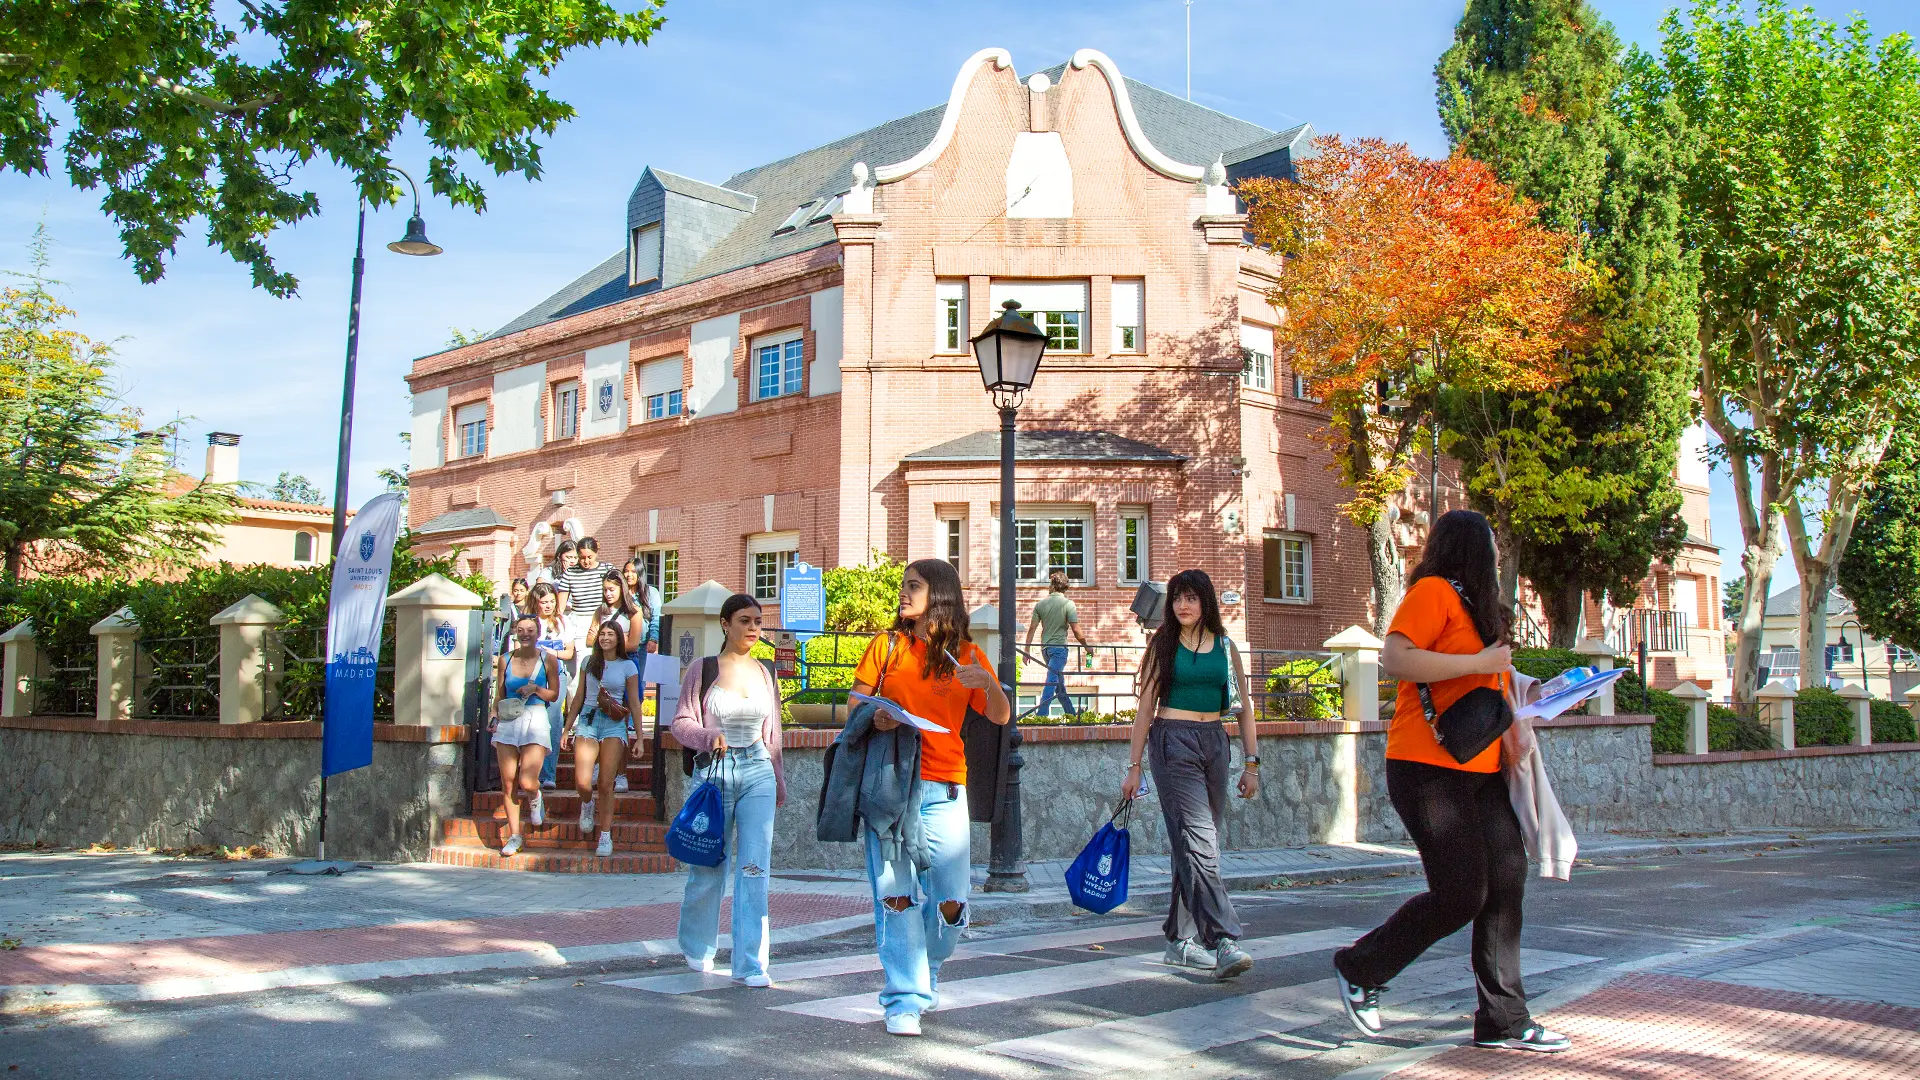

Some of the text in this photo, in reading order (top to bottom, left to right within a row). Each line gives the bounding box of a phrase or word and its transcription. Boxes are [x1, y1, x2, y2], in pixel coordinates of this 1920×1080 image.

[676, 827, 696, 840] SAINT
[678, 835, 716, 849] UNIVERSITY
[682, 842, 709, 854] MADRID
